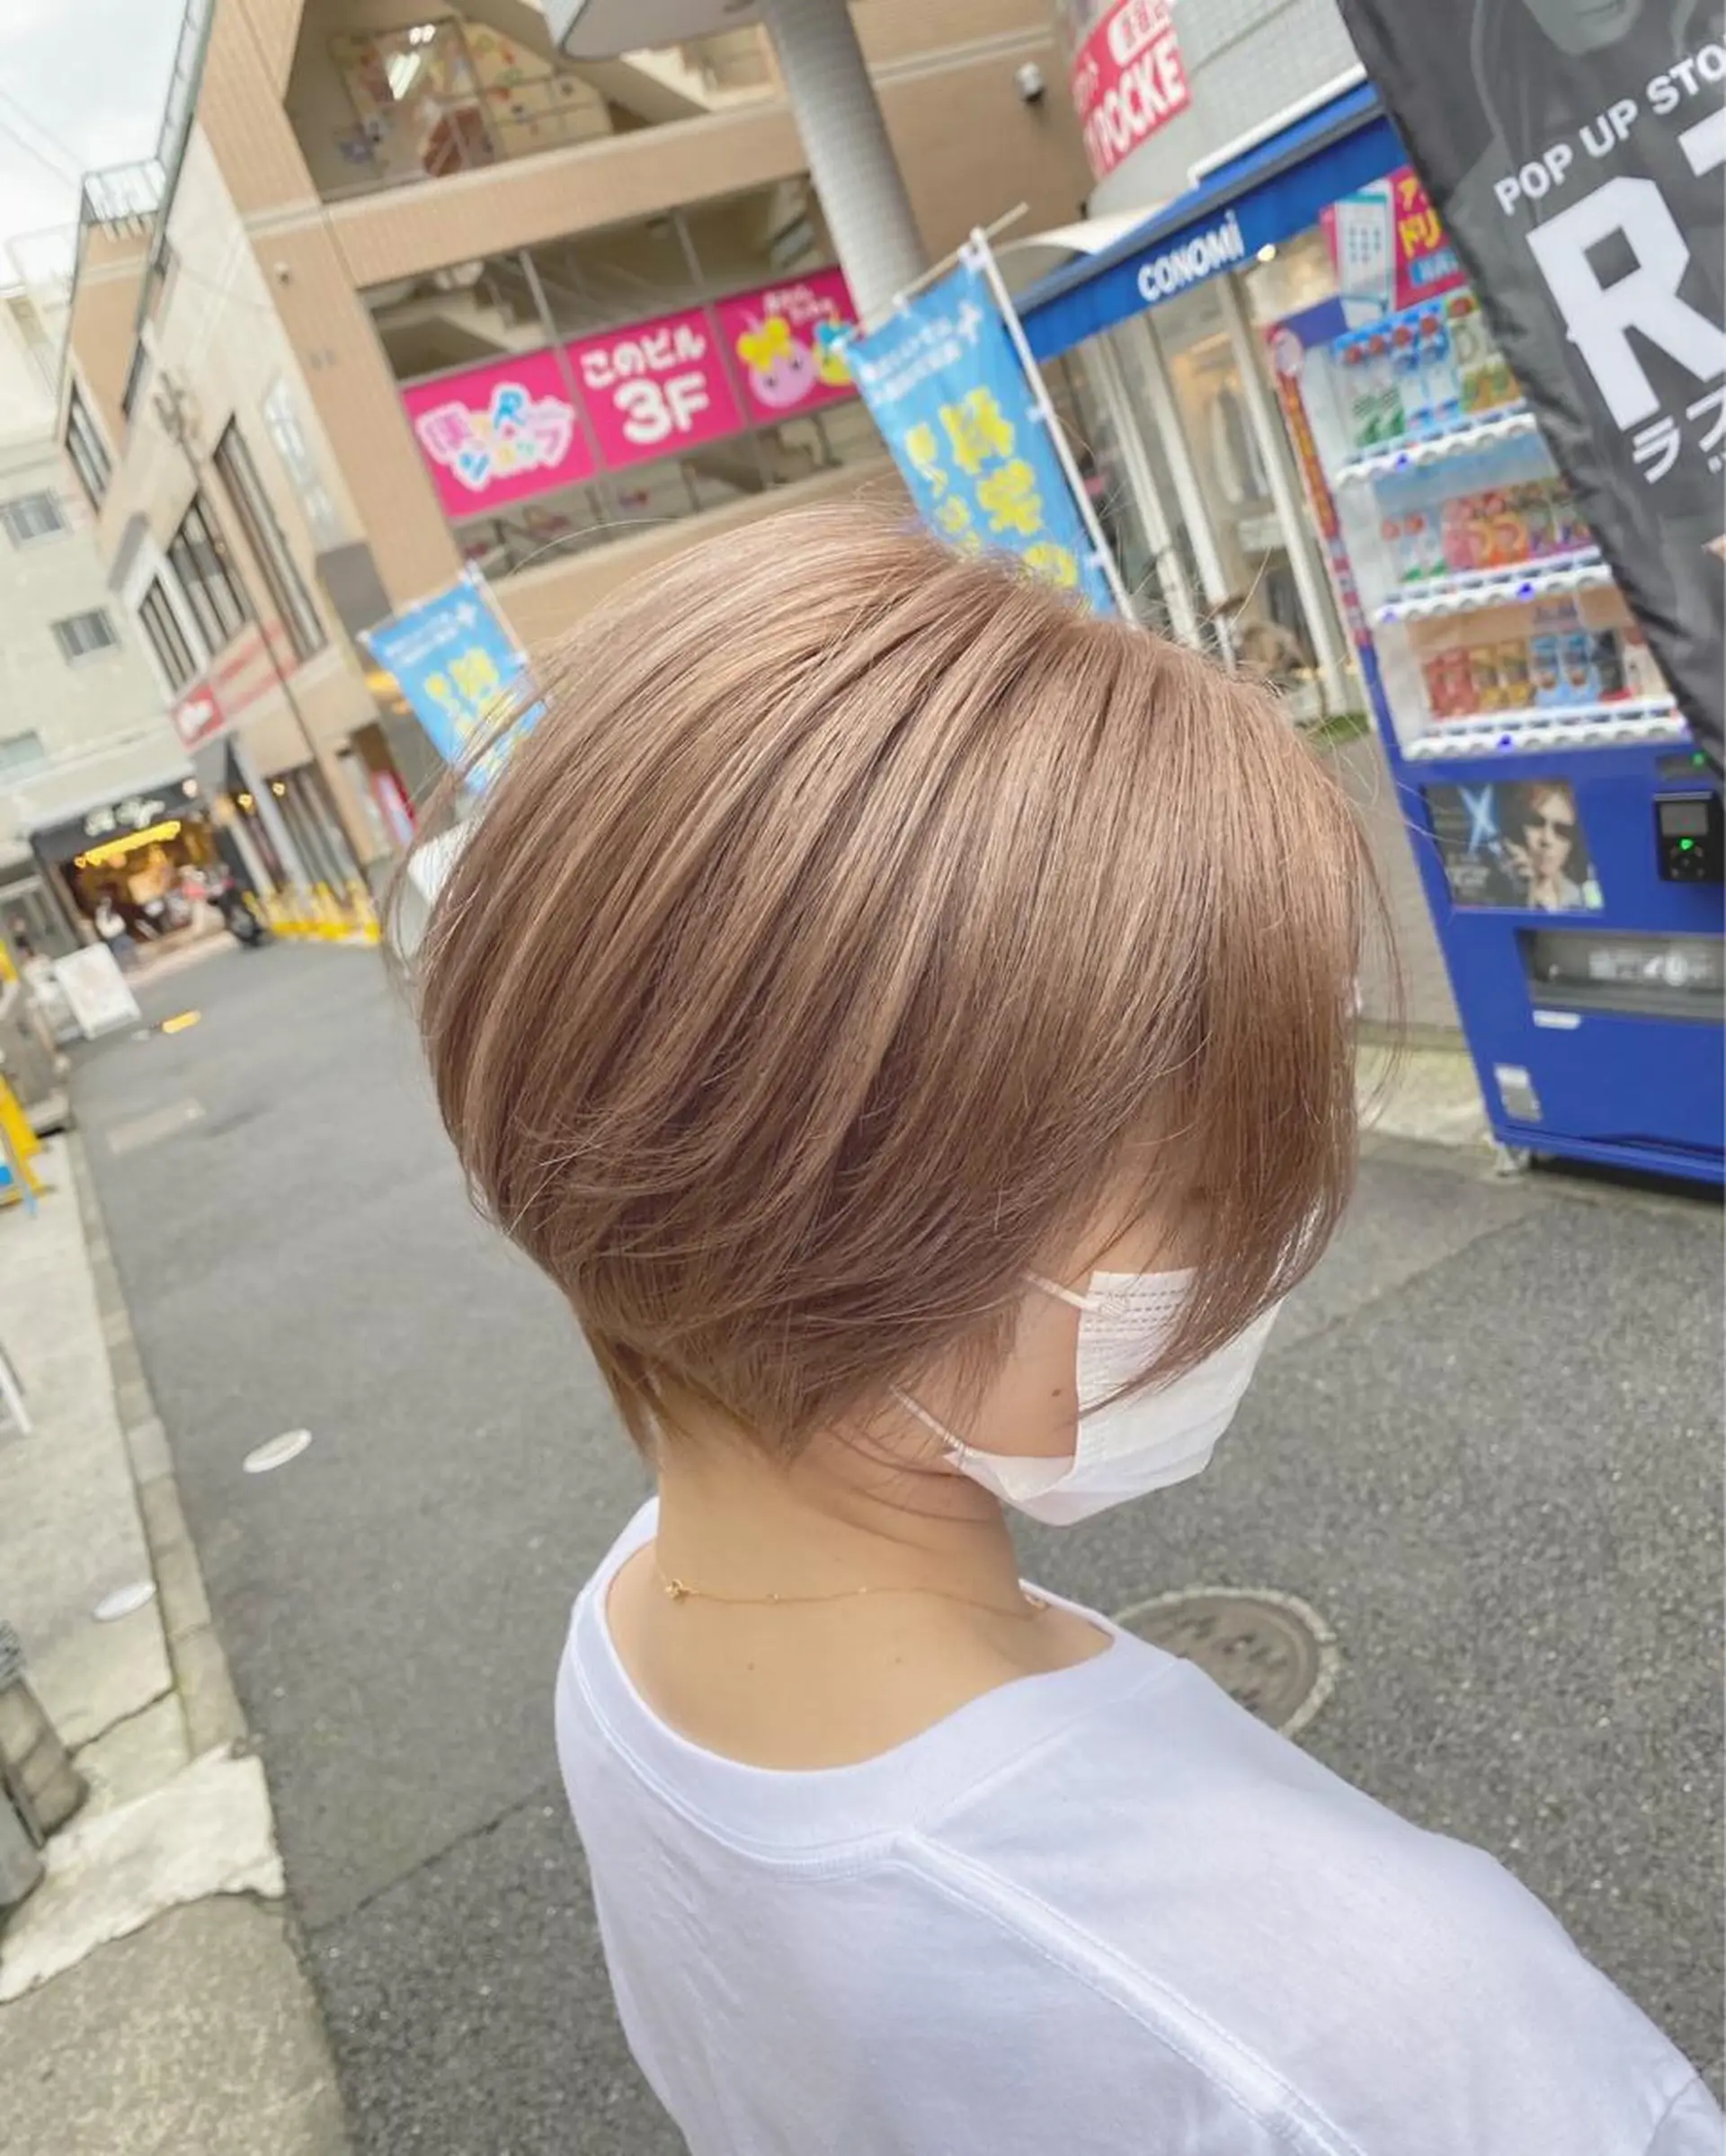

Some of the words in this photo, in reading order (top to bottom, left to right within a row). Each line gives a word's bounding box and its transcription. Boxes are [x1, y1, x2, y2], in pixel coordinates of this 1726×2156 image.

[1493, 143, 1573, 217] POP
[1579, 99, 1639, 158] UP
[580, 324, 707, 389] このビル
[613, 372, 710, 445] 3F
